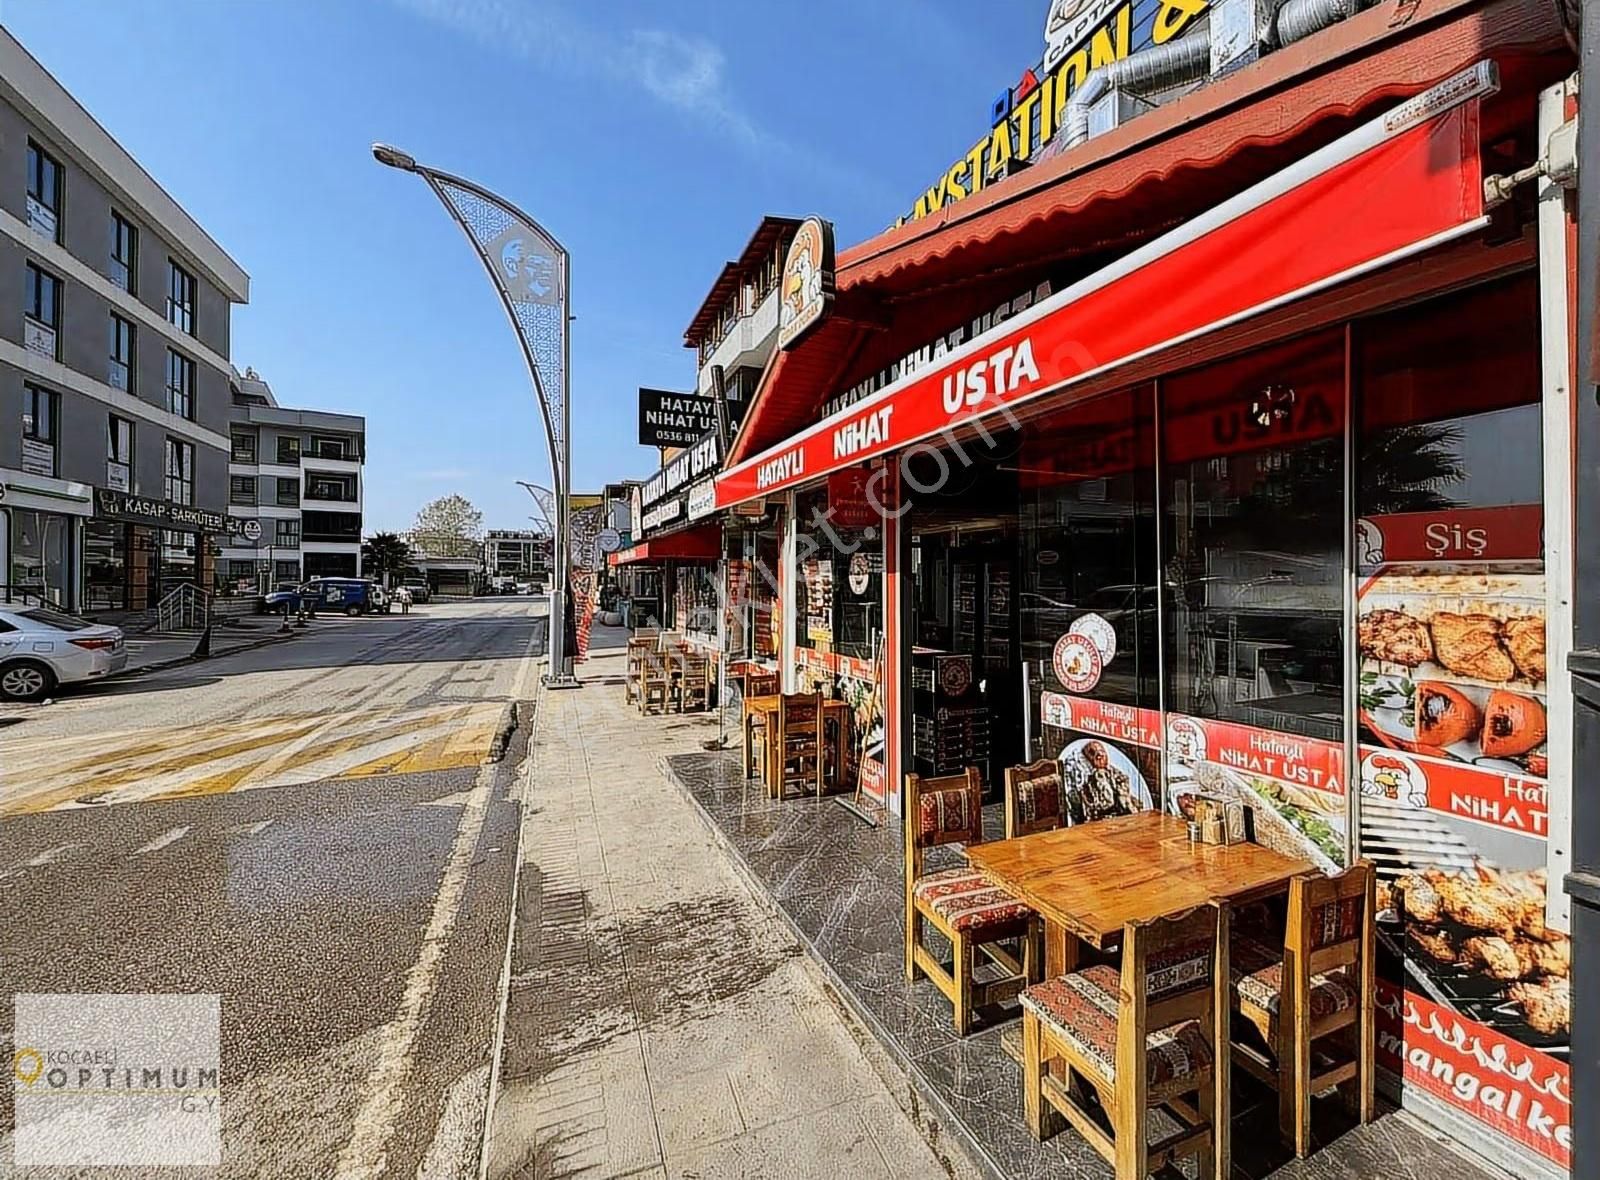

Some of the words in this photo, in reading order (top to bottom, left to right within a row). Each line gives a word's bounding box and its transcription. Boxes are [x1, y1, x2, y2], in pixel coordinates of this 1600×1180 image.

[757, 446, 804, 490] HATAYLI
[942, 336, 1041, 414] USTA
[656, 430, 683, 441] 0536
[691, 436, 718, 477] USTA
[125, 498, 166, 518] KASAP
[1425, 523, 1489, 557] Şiş
[1283, 761, 1341, 793] USTA
